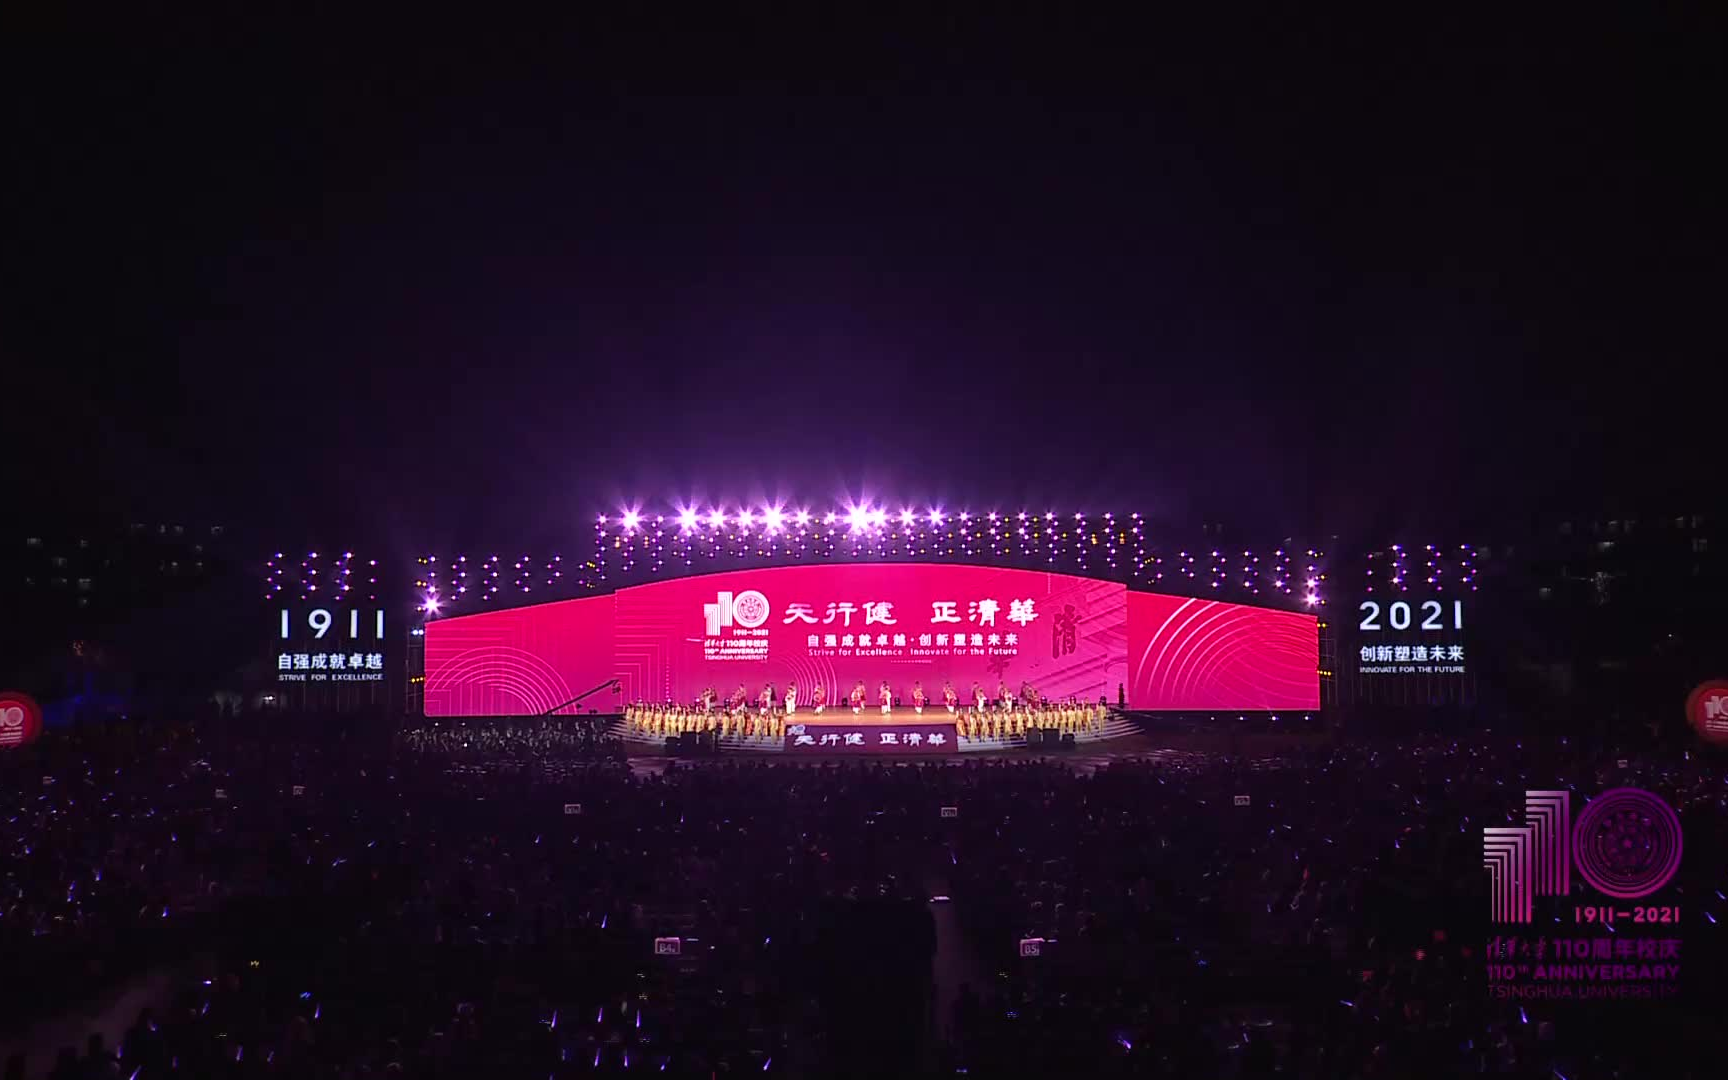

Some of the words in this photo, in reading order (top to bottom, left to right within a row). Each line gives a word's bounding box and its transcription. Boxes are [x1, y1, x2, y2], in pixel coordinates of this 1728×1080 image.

[281, 608, 384, 638] 1911
[1359, 600, 1463, 630] 2021
[808, 648, 835, 656] Strive
[839, 648, 852, 656] for
[855, 647, 903, 656] Excellence
[910, 647, 950, 655] Innovate
[953, 647, 967, 655] for
[970, 647, 985, 655] the
[988, 647, 1018, 655] Future
[1360, 645, 1465, 662] 创新塑造未来
[278, 653, 383, 670] 自强成就卓越
[331, 673, 384, 681] EXCELLENCE
